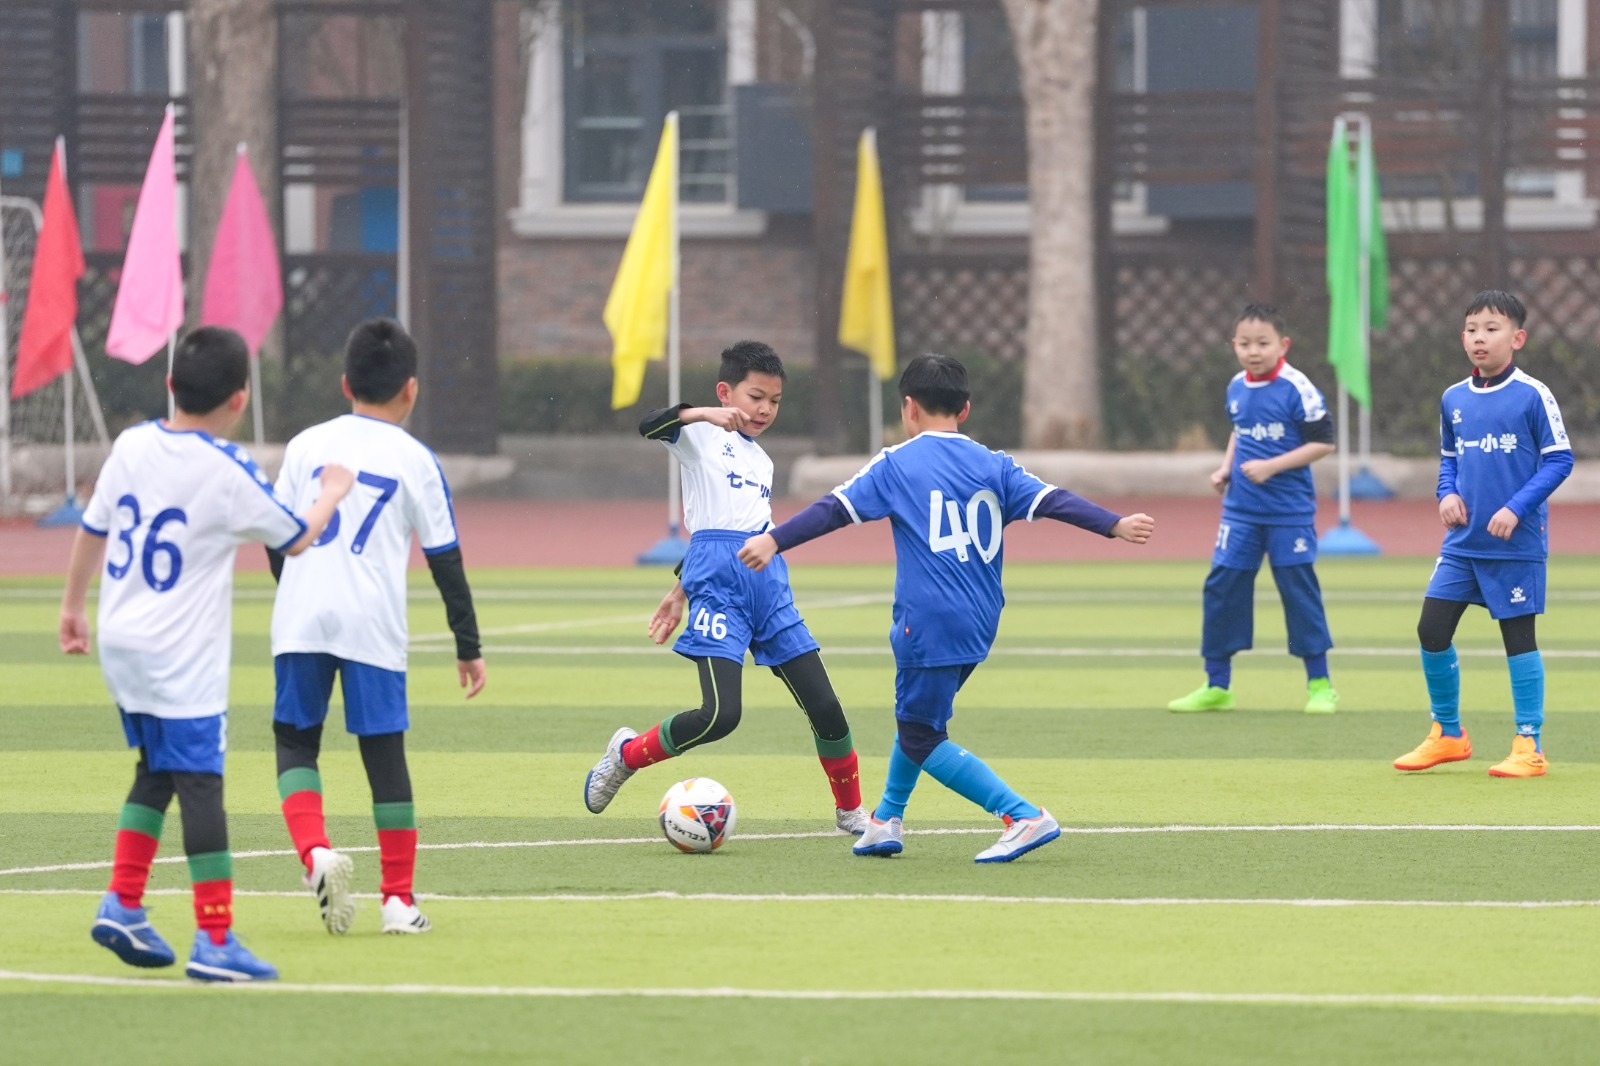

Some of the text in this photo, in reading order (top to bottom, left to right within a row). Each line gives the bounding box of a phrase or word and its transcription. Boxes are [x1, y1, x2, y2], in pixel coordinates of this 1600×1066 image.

[106, 493, 188, 593] 36
[928, 489, 1003, 565] 40
[693, 608, 728, 641] 46
[671, 823, 707, 842] KELME
